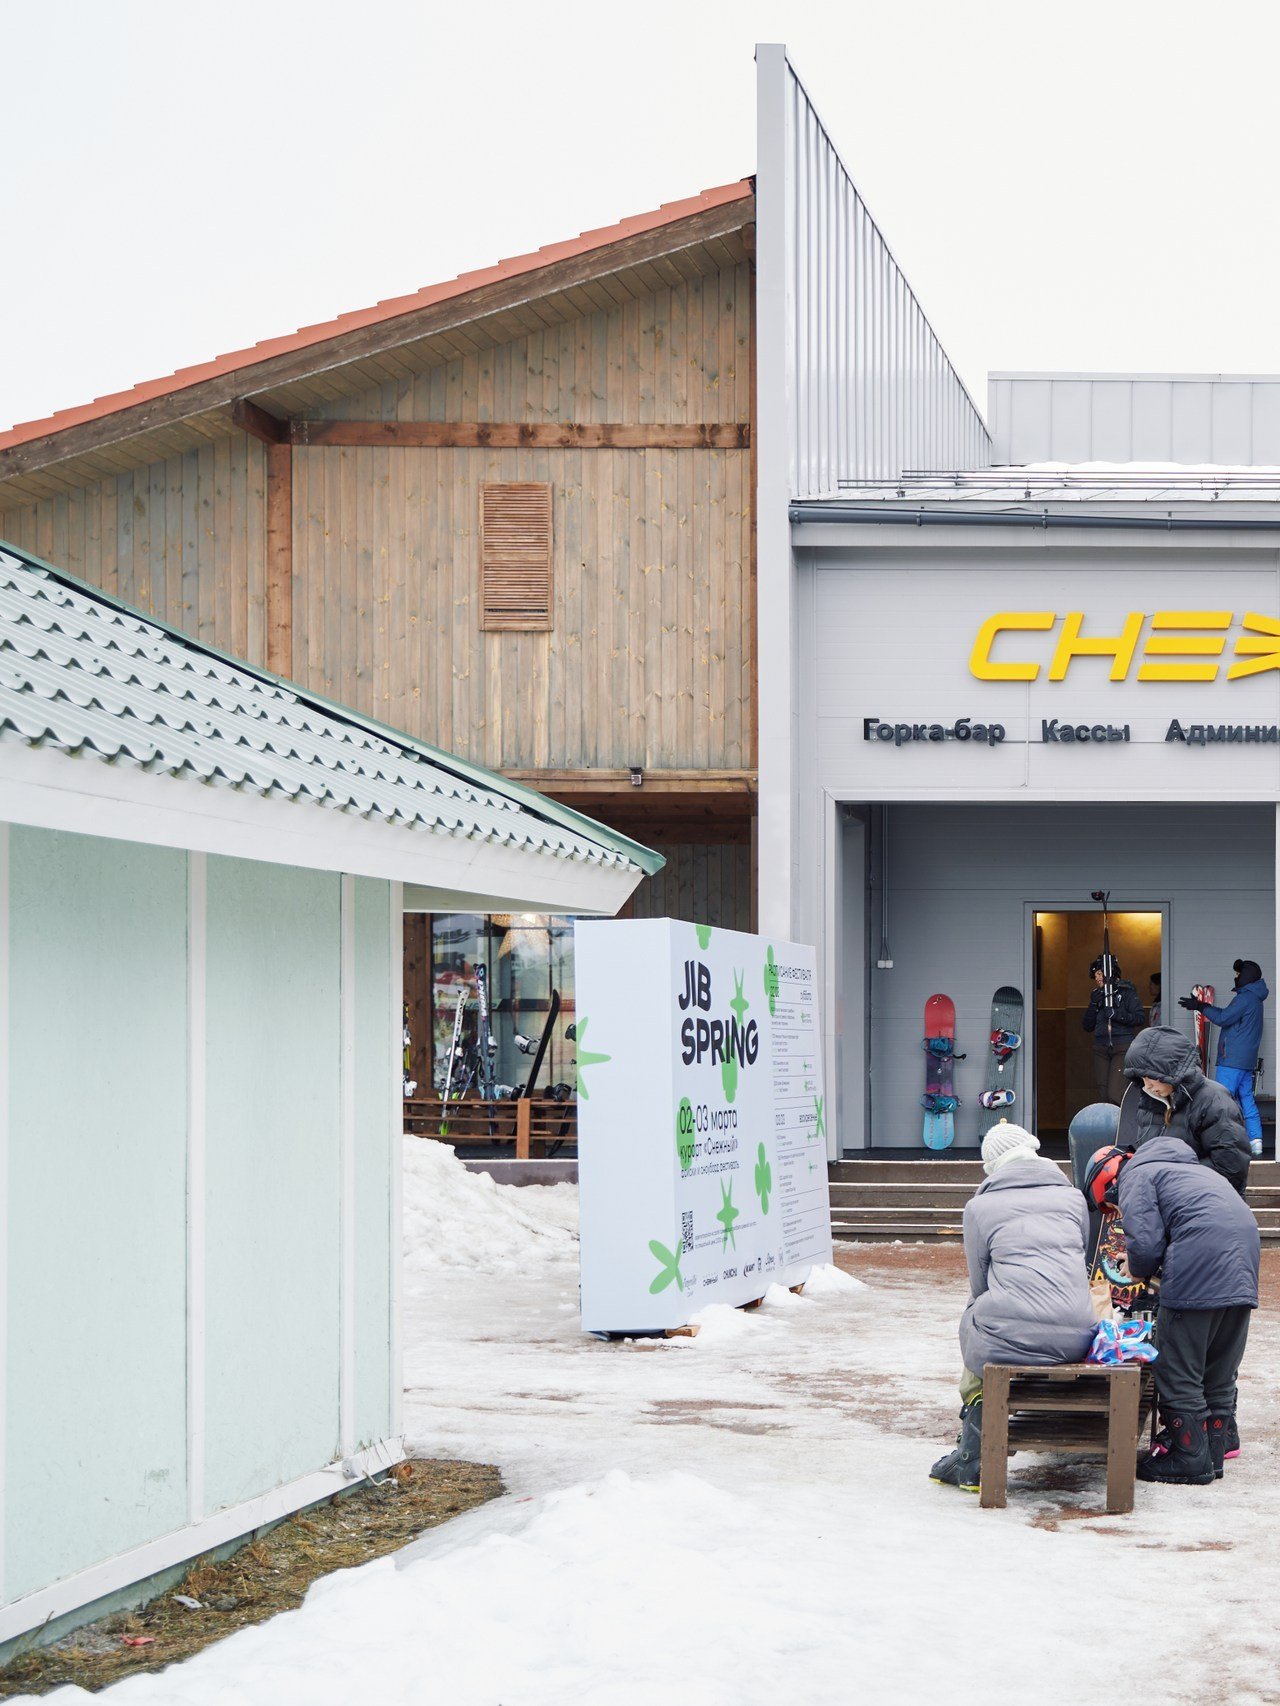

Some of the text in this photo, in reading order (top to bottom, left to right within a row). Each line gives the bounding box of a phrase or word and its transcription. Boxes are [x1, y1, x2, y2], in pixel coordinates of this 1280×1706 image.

[863, 717, 1006, 747] Горка-бар
[1041, 718, 1131, 743] Кассы
[678, 959, 712, 1012] JIB
[681, 1014, 759, 1070] SPRING
[679, 1104, 738, 1135] 02-03 марта
[679, 1143, 702, 1163] курорт
